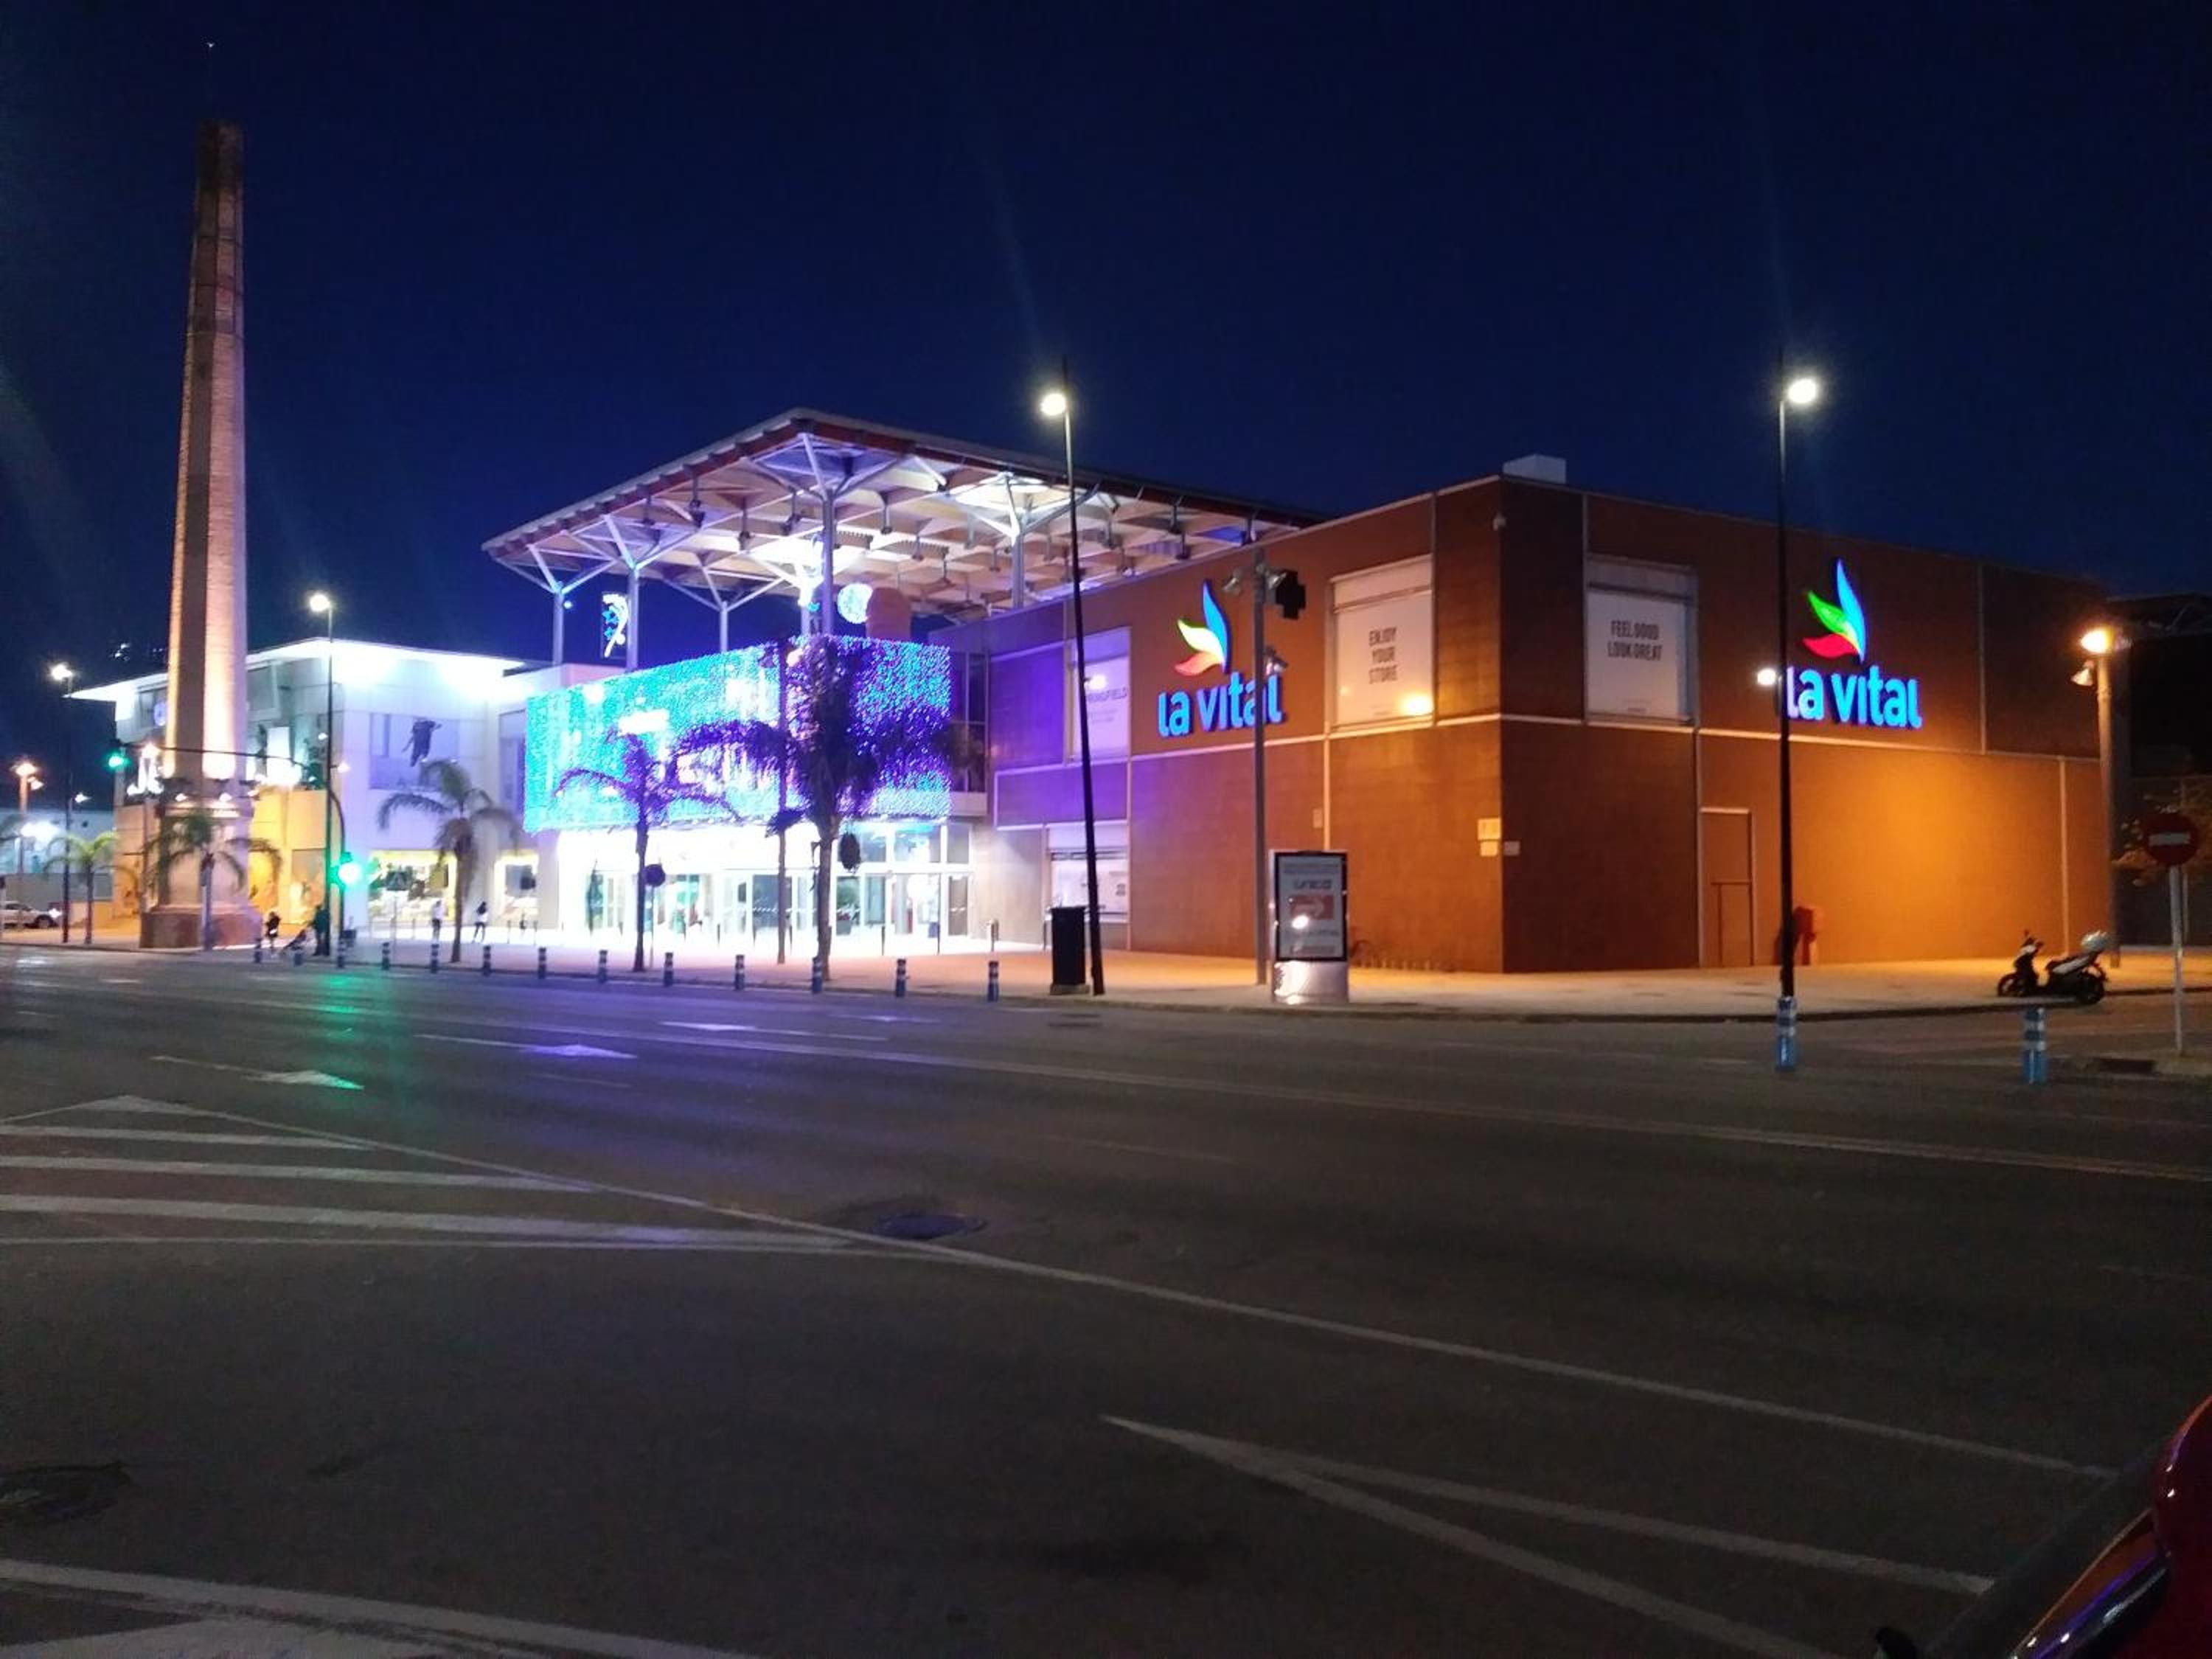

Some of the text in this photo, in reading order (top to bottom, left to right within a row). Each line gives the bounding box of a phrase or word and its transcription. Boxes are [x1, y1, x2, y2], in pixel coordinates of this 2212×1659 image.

[1368, 627, 1397, 647] ENJOY
[1610, 620, 1659, 640] FEEL GOOD
[1372, 647, 1395, 663] YOUR
[1607, 641, 1662, 661] LOOK GREAT
[1368, 664, 1398, 685] STORE
[1158, 672, 1282, 737] la vital
[1787, 665, 1922, 728] la vital
